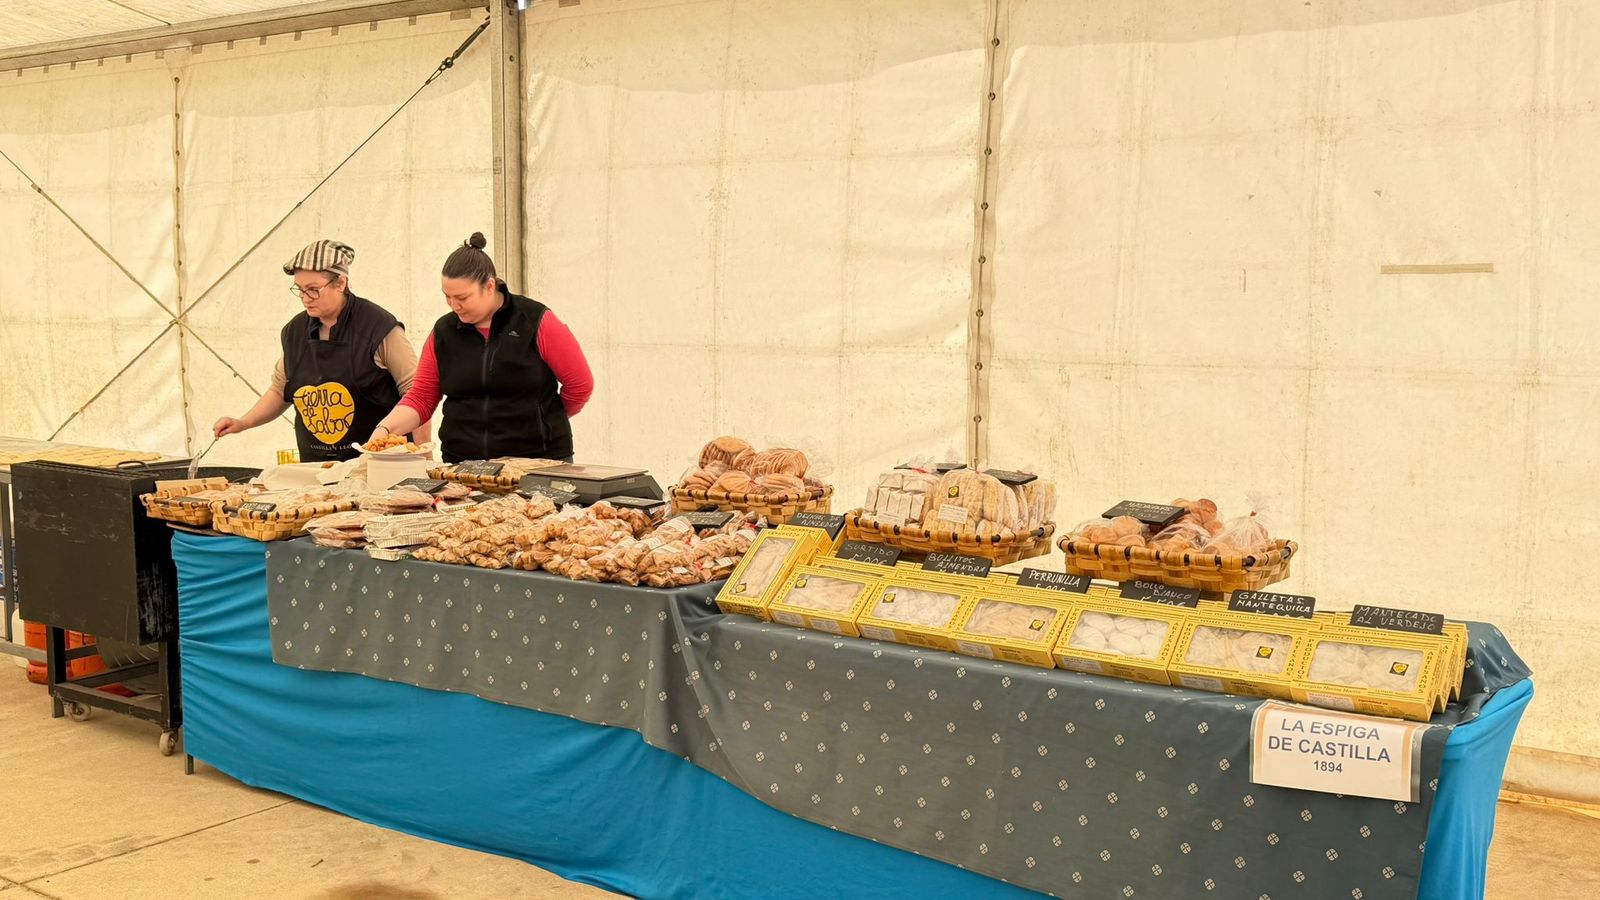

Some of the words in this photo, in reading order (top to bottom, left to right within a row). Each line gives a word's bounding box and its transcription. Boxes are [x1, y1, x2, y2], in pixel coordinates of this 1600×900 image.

[845, 543, 894, 557] SURTIDO
[1028, 569, 1080, 588] PERRUNILLA
[1356, 616, 1372, 625] AL
[1281, 718, 1304, 733] LA
[1310, 721, 1380, 740] ESPIGA
[1268, 735, 1293, 751] DE
[1298, 739, 1391, 763] CASTILLA
[1313, 760, 1343, 774] 1894
